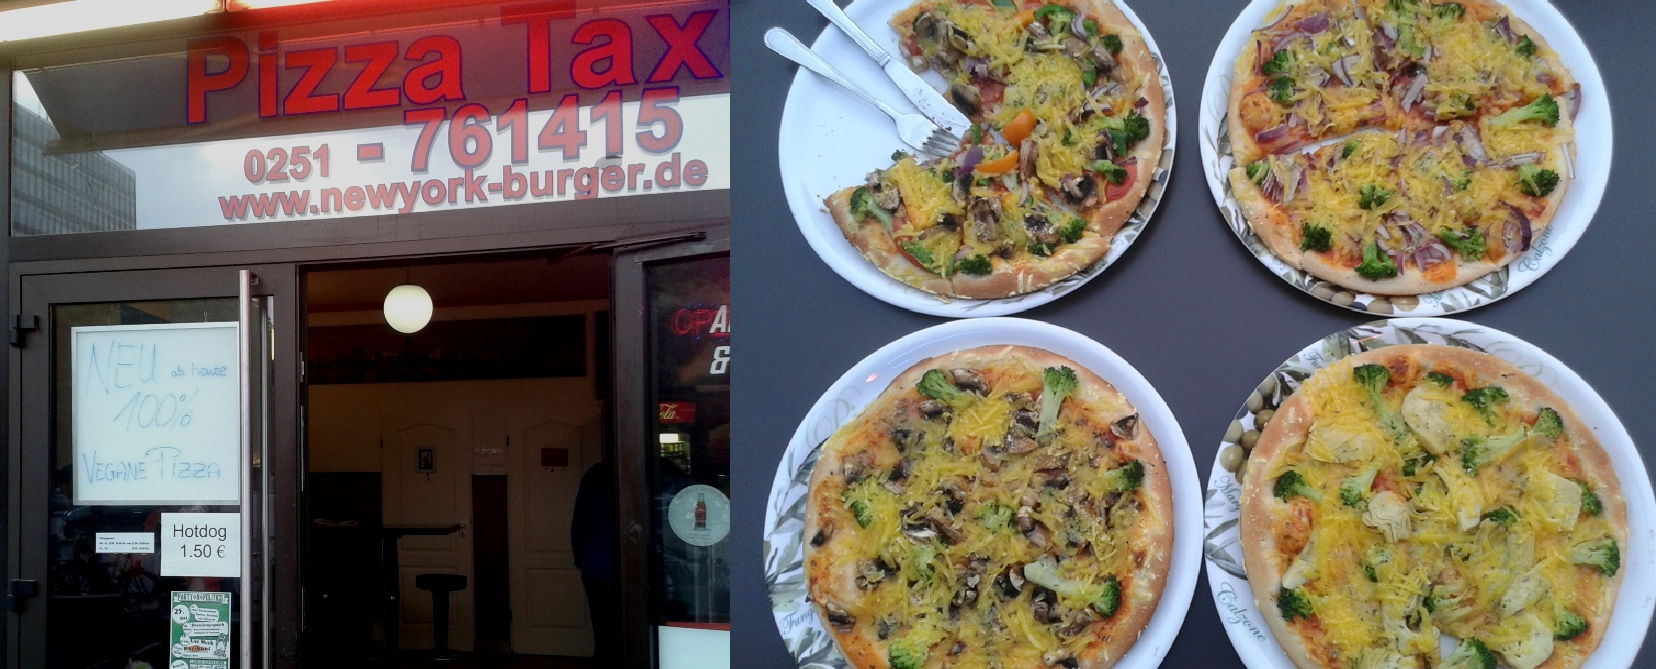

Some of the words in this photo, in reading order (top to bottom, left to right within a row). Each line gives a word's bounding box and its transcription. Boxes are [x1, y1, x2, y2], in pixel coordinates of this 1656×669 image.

[187, 33, 467, 126] Pizza
[502, 0, 730, 95] Tax
[243, 143, 331, 183] 0251
[402, 87, 684, 172] 761415
[218, 152, 709, 222] www.newyork-burger.de
[708, 304, 730, 333] A
[85, 339, 157, 395] NEU
[170, 365, 186, 377] ab
[191, 362, 227, 377] heute
[113, 387, 199, 431] 100%
[82, 450, 147, 484] VEGANE
[173, 523, 227, 542] Hotdog
[180, 544, 212, 558] 1.50
[216, 544, 226, 559] €
[1216, 581, 1267, 642] Calzone
